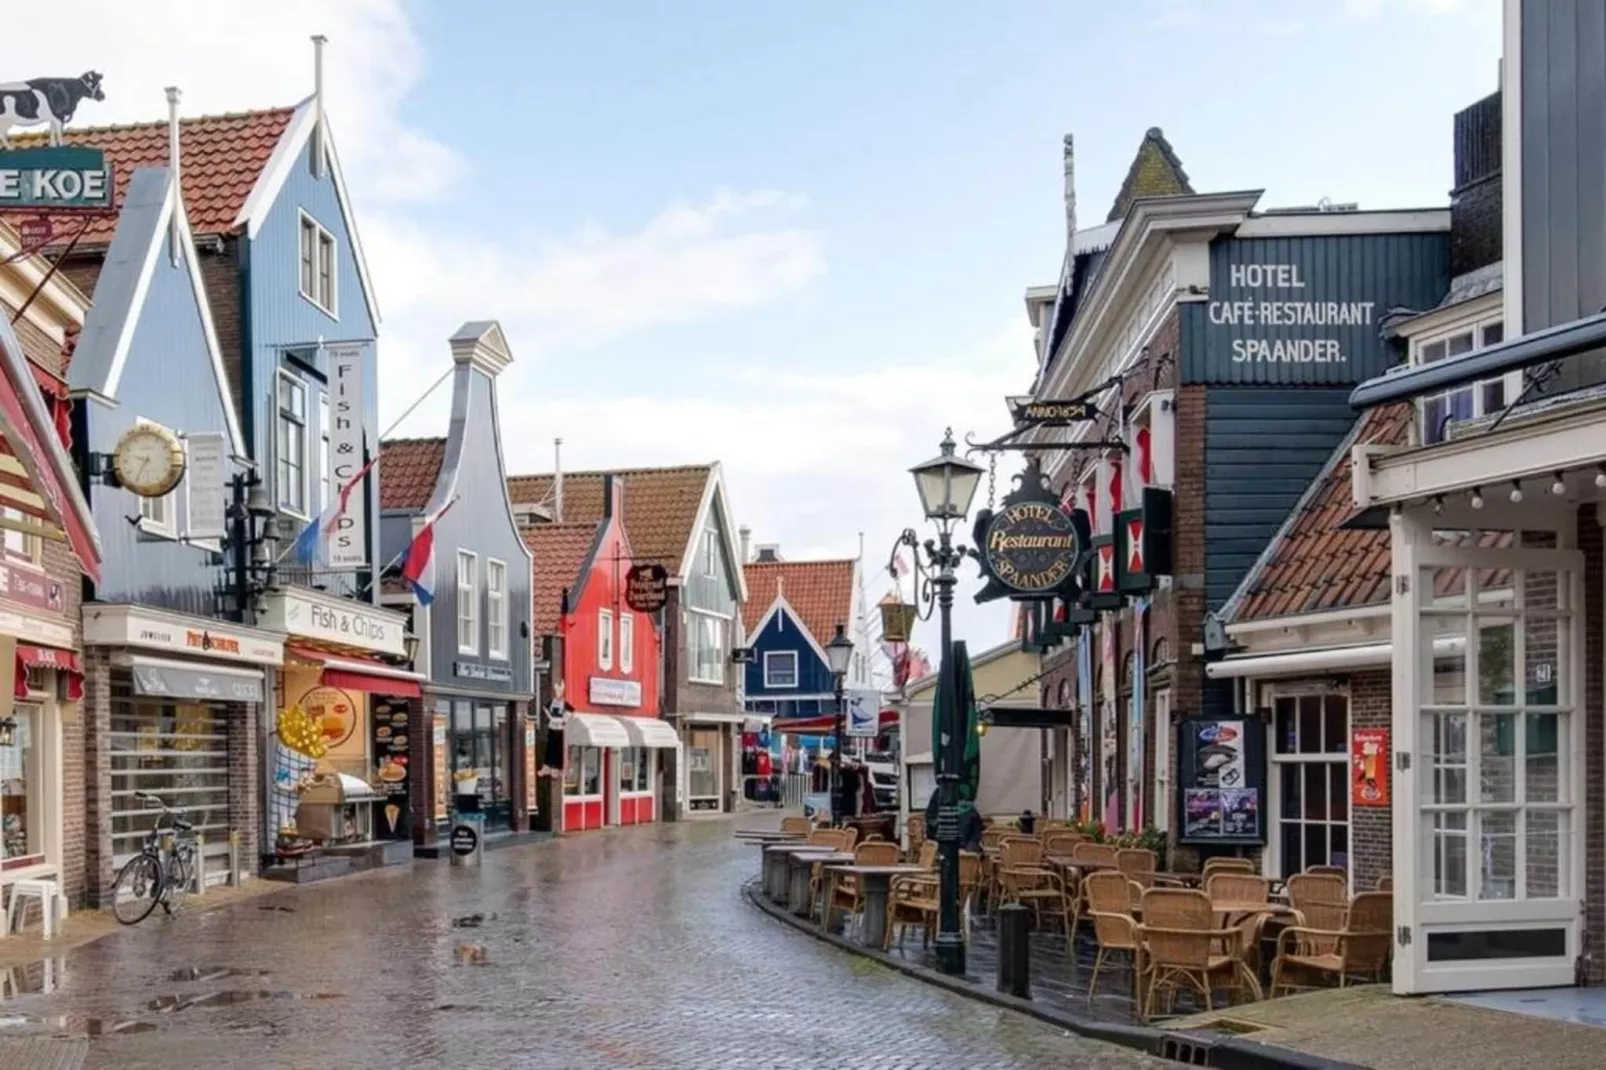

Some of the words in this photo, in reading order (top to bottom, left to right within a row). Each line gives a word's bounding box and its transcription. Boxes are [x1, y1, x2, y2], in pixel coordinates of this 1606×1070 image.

[33, 170, 104, 199] KOE
[1230, 264, 1305, 288] HOTEL
[1232, 340, 1347, 363] SPAANDER.
[336, 365, 352, 429] Fish
[336, 443, 354, 454] &
[1005, 505, 1053, 524] HOTEL
[990, 530, 1073, 552] Restaurant
[996, 560, 1069, 588] SPAANDER
[311, 605, 338, 630] Fish
[340, 616, 350, 632] &
[352, 614, 385, 640] Chips
